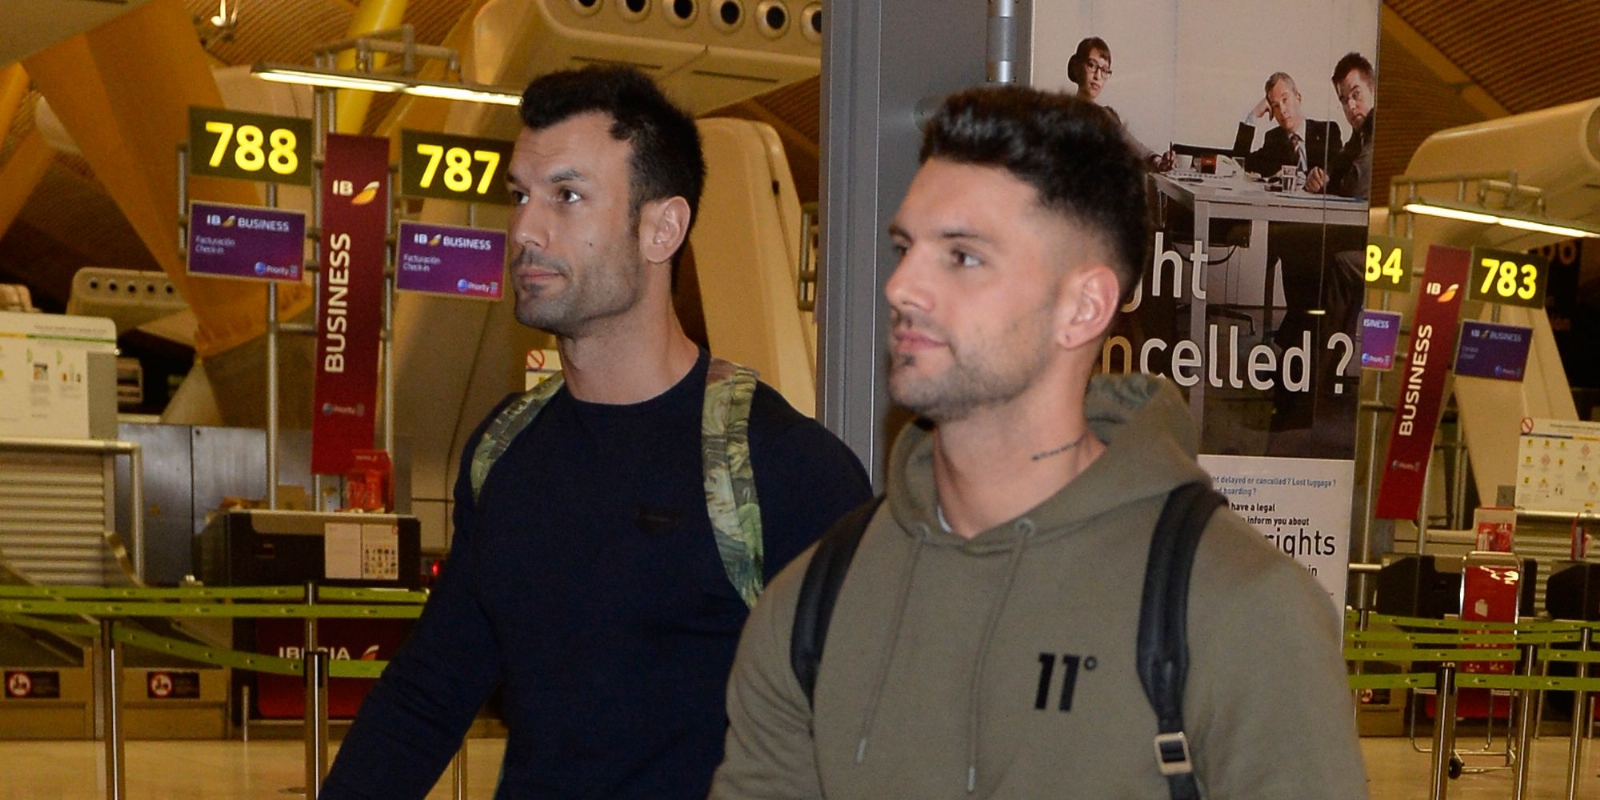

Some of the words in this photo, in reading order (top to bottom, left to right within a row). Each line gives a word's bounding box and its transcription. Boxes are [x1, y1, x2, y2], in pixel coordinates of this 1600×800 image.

[205, 121, 299, 175] 788
[416, 143, 500, 195] 787
[332, 179, 354, 197] IB
[206, 214, 221, 226] IB
[237, 217, 290, 232] BUSINESS
[414, 233, 428, 245] IB
[443, 235, 492, 251] BUSINESS
[1121, 232, 1210, 313] ht
[1364, 244, 1404, 284] 84
[1479, 257, 1538, 300] 783
[1426, 282, 1442, 296] IB
[324, 233, 351, 373] BUSINESS
[1102, 324, 1312, 393] ncelled
[1398, 324, 1433, 436] BUSINESS
[1220, 476, 1246, 485] delayed
[1292, 478, 1306, 486] Lost
[1307, 478, 1332, 488] luggage
[1223, 487, 1252, 497] boarding
[1231, 502, 1249, 512] have
[1250, 504, 1255, 512] a
[1256, 503, 1276, 513] legal
[1247, 515, 1272, 525] inform
[1273, 518, 1287, 527] you
[1288, 517, 1309, 526] about
[278, 646, 351, 661] IBIA
